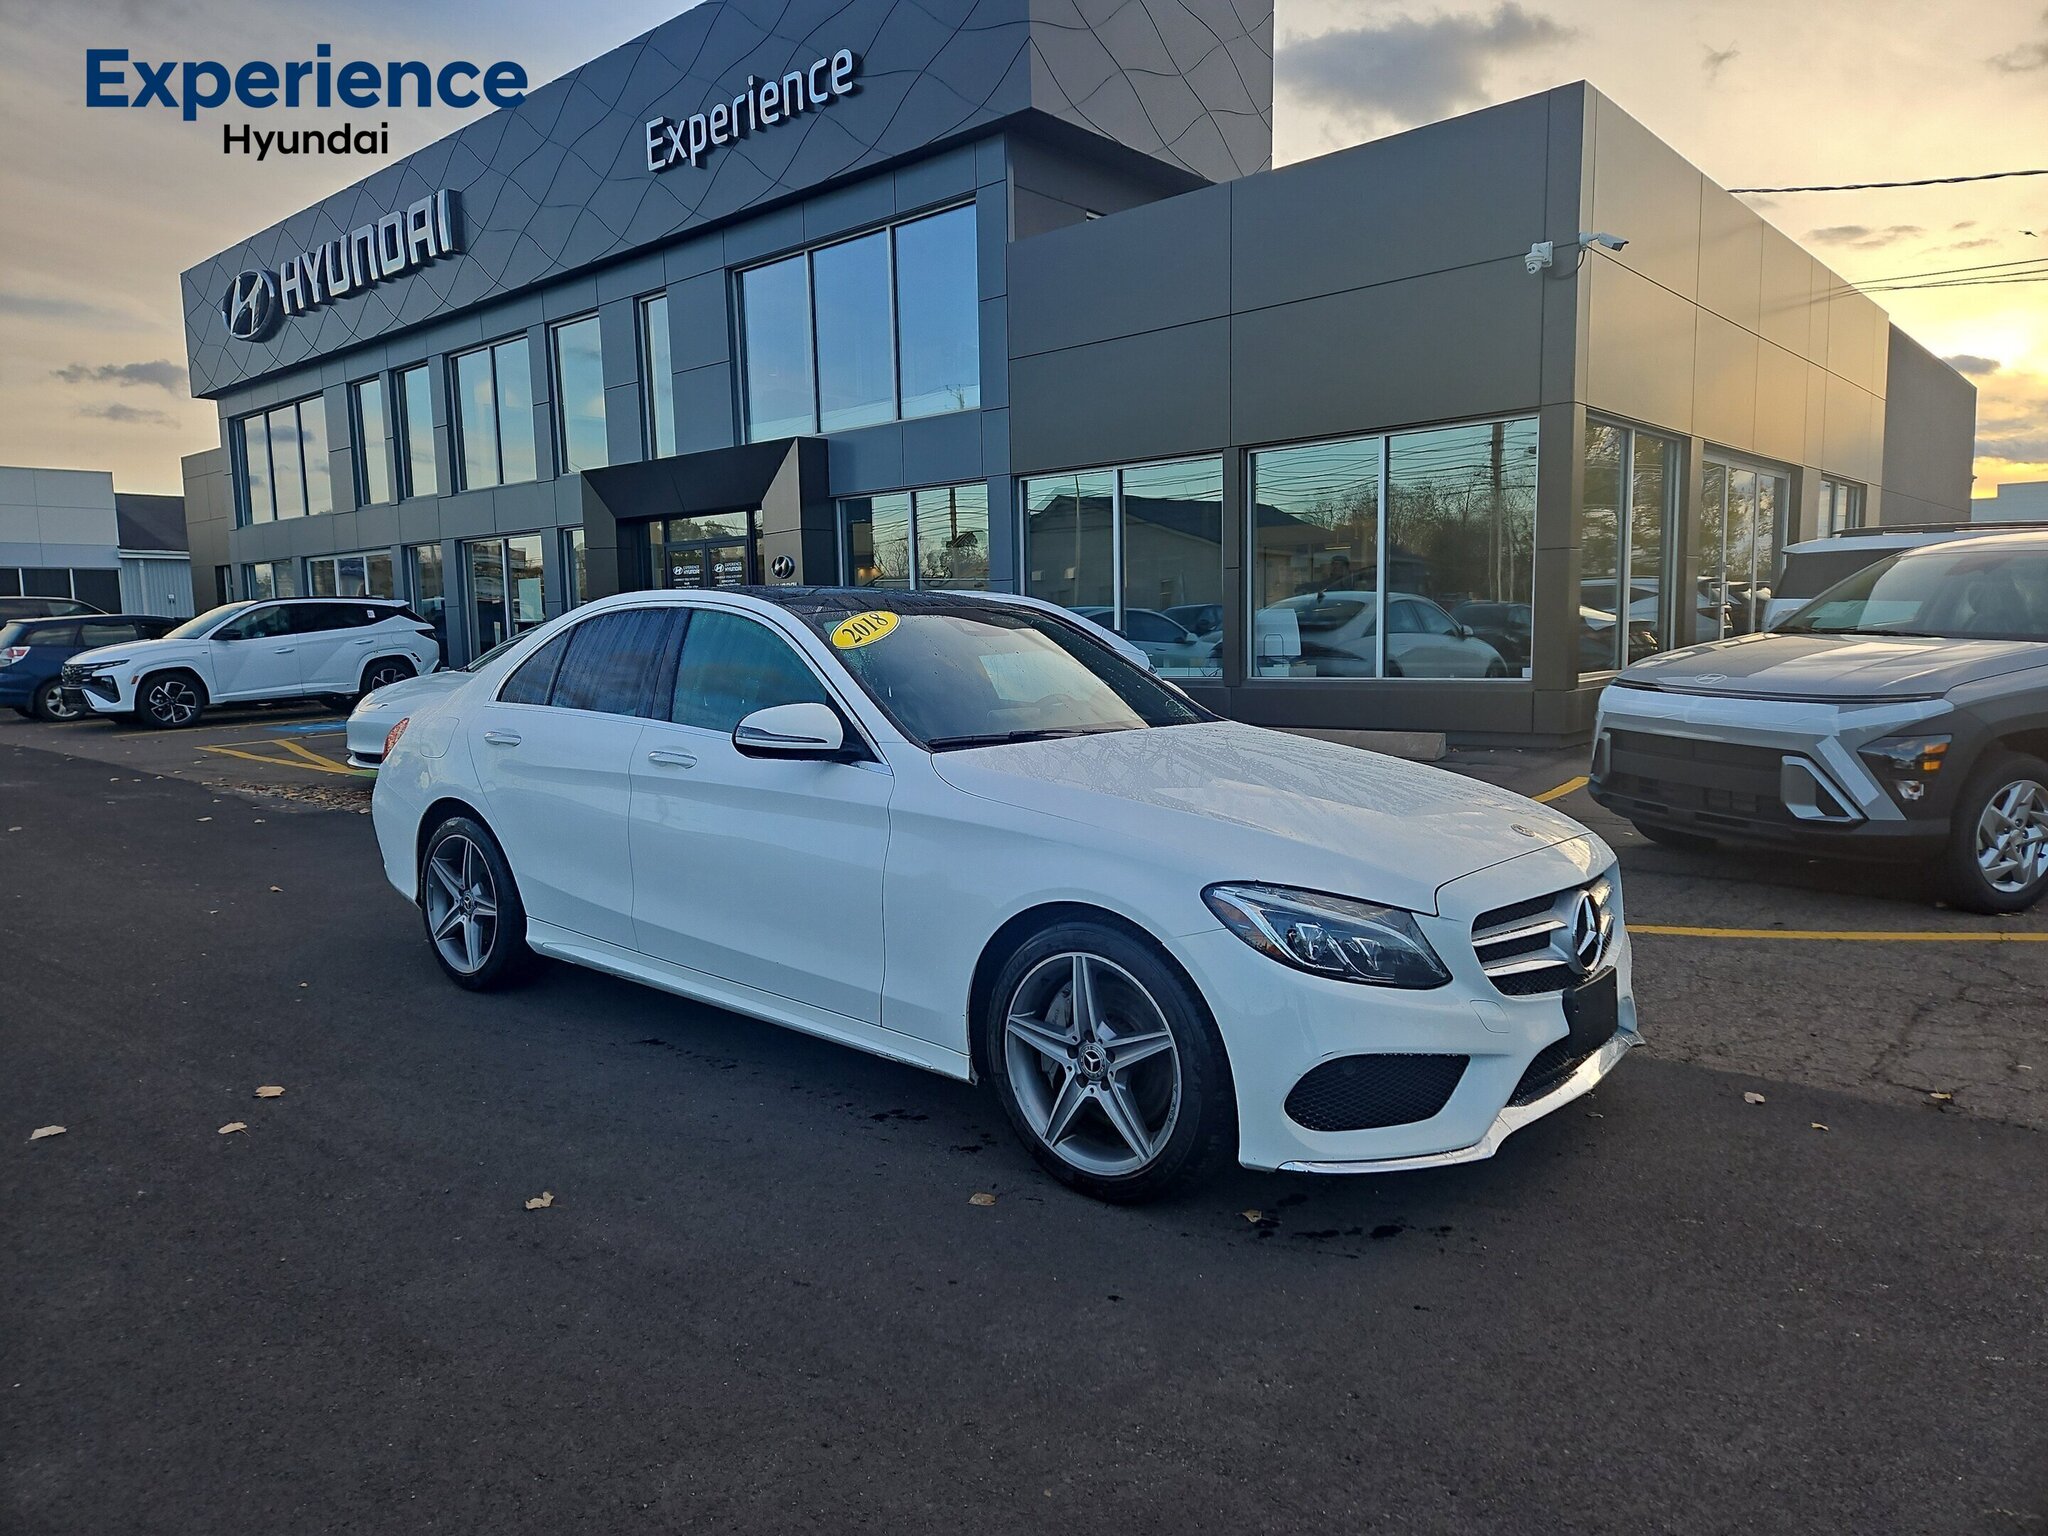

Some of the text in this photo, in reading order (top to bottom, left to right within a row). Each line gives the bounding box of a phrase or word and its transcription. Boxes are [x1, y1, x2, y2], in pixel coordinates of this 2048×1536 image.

[645, 48, 853, 172] Experience
[280, 189, 453, 315] HYUNDAI
[842, 613, 889, 643] 2018
